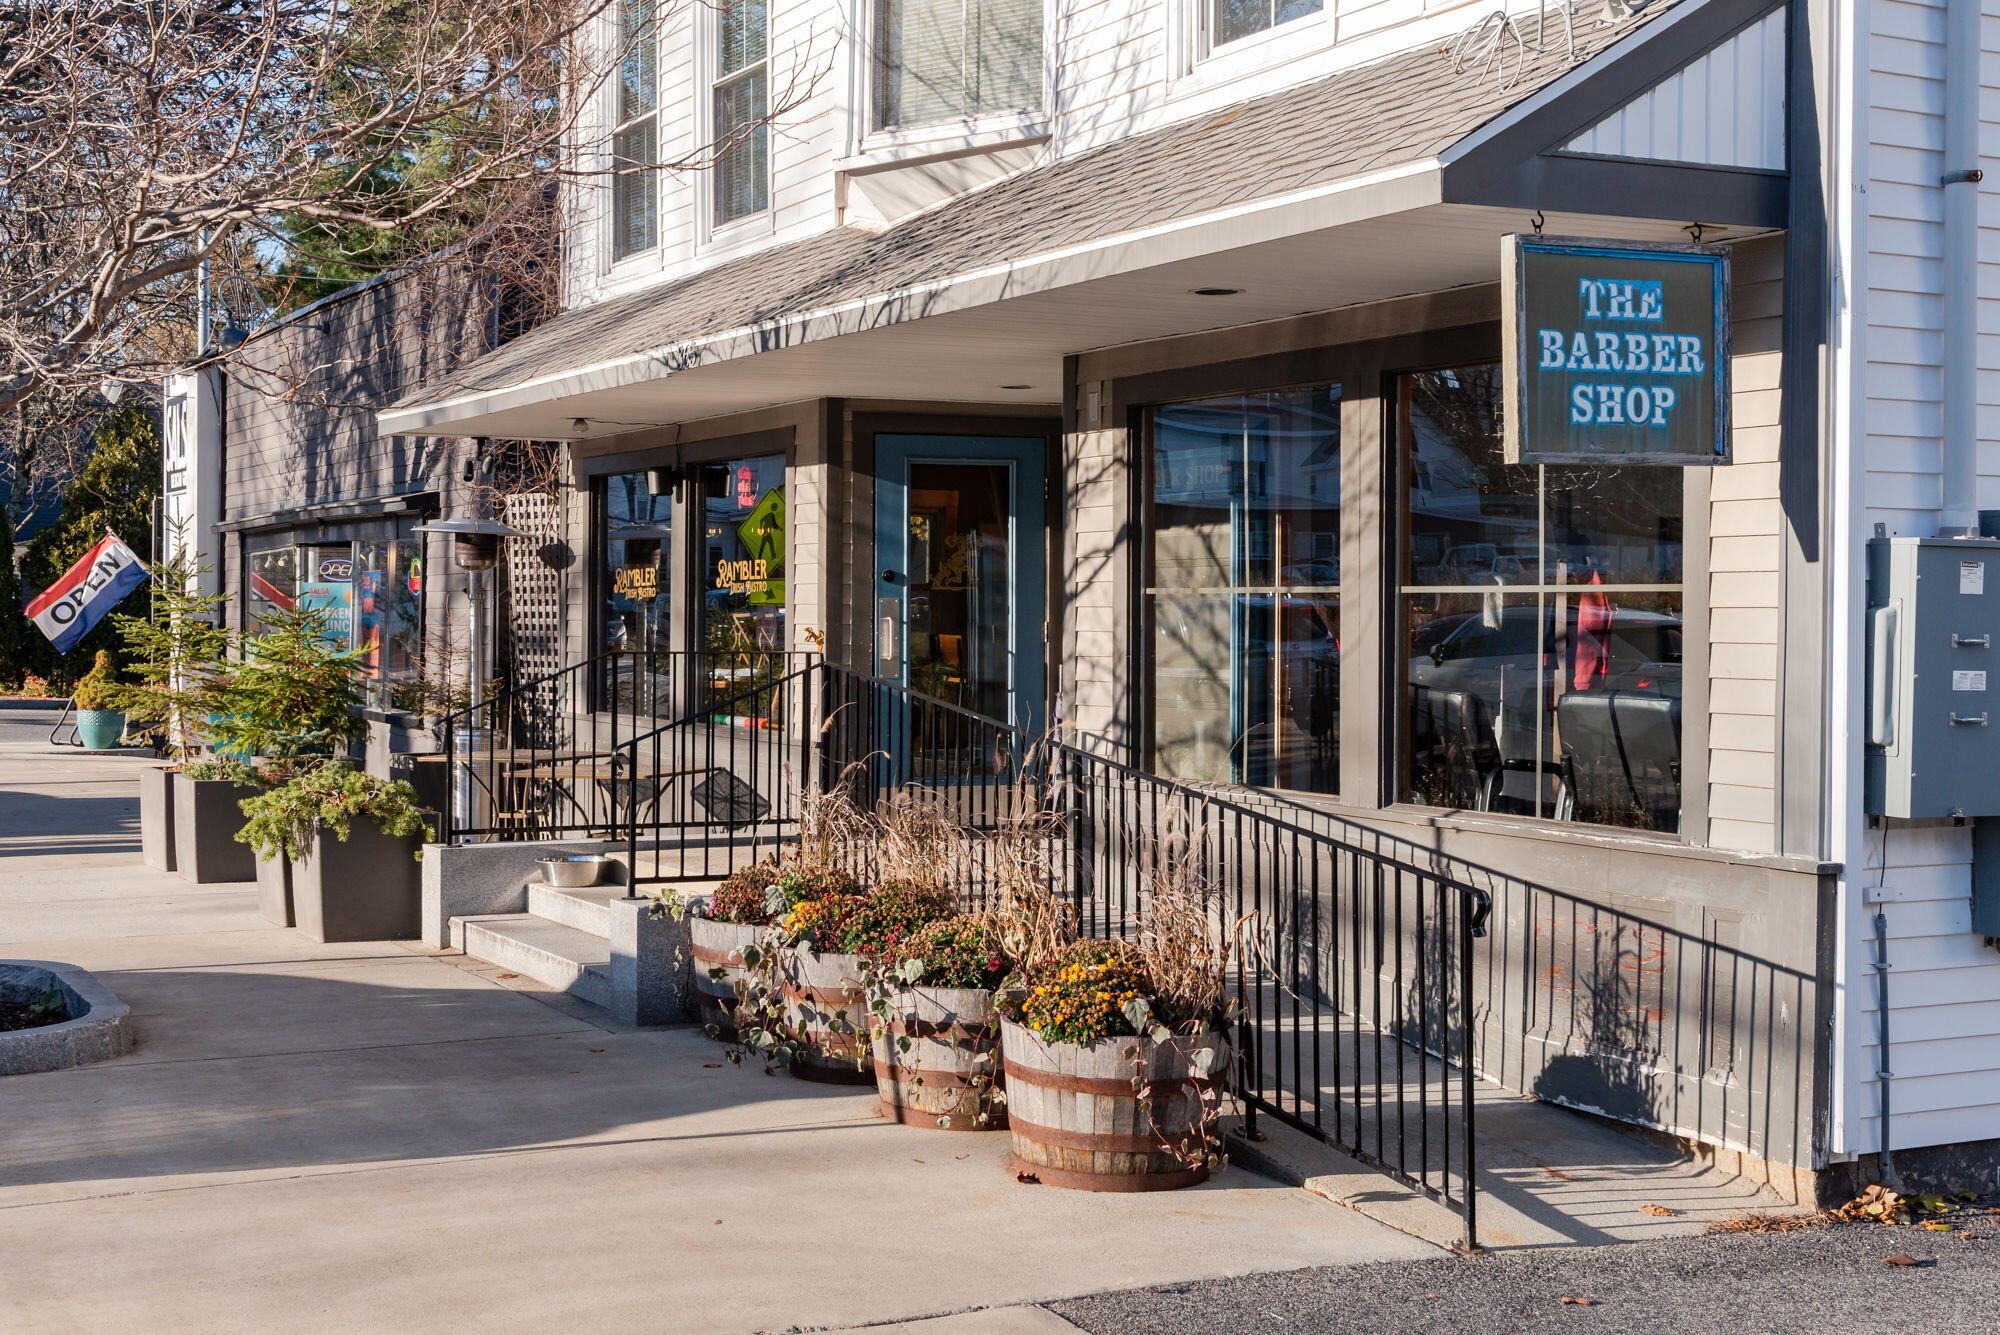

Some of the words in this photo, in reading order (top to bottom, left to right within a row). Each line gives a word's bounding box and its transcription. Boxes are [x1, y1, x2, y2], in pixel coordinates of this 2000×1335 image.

[1580, 279, 1662, 319] THE
[1539, 329, 1704, 374] BARBER
[1571, 384, 1676, 424] SHOP
[50, 551, 121, 625] OPEN
[613, 568, 656, 593] RAMBLER
[716, 559, 767, 588] RAMBLER
[745, 581, 768, 596] BISTRO
